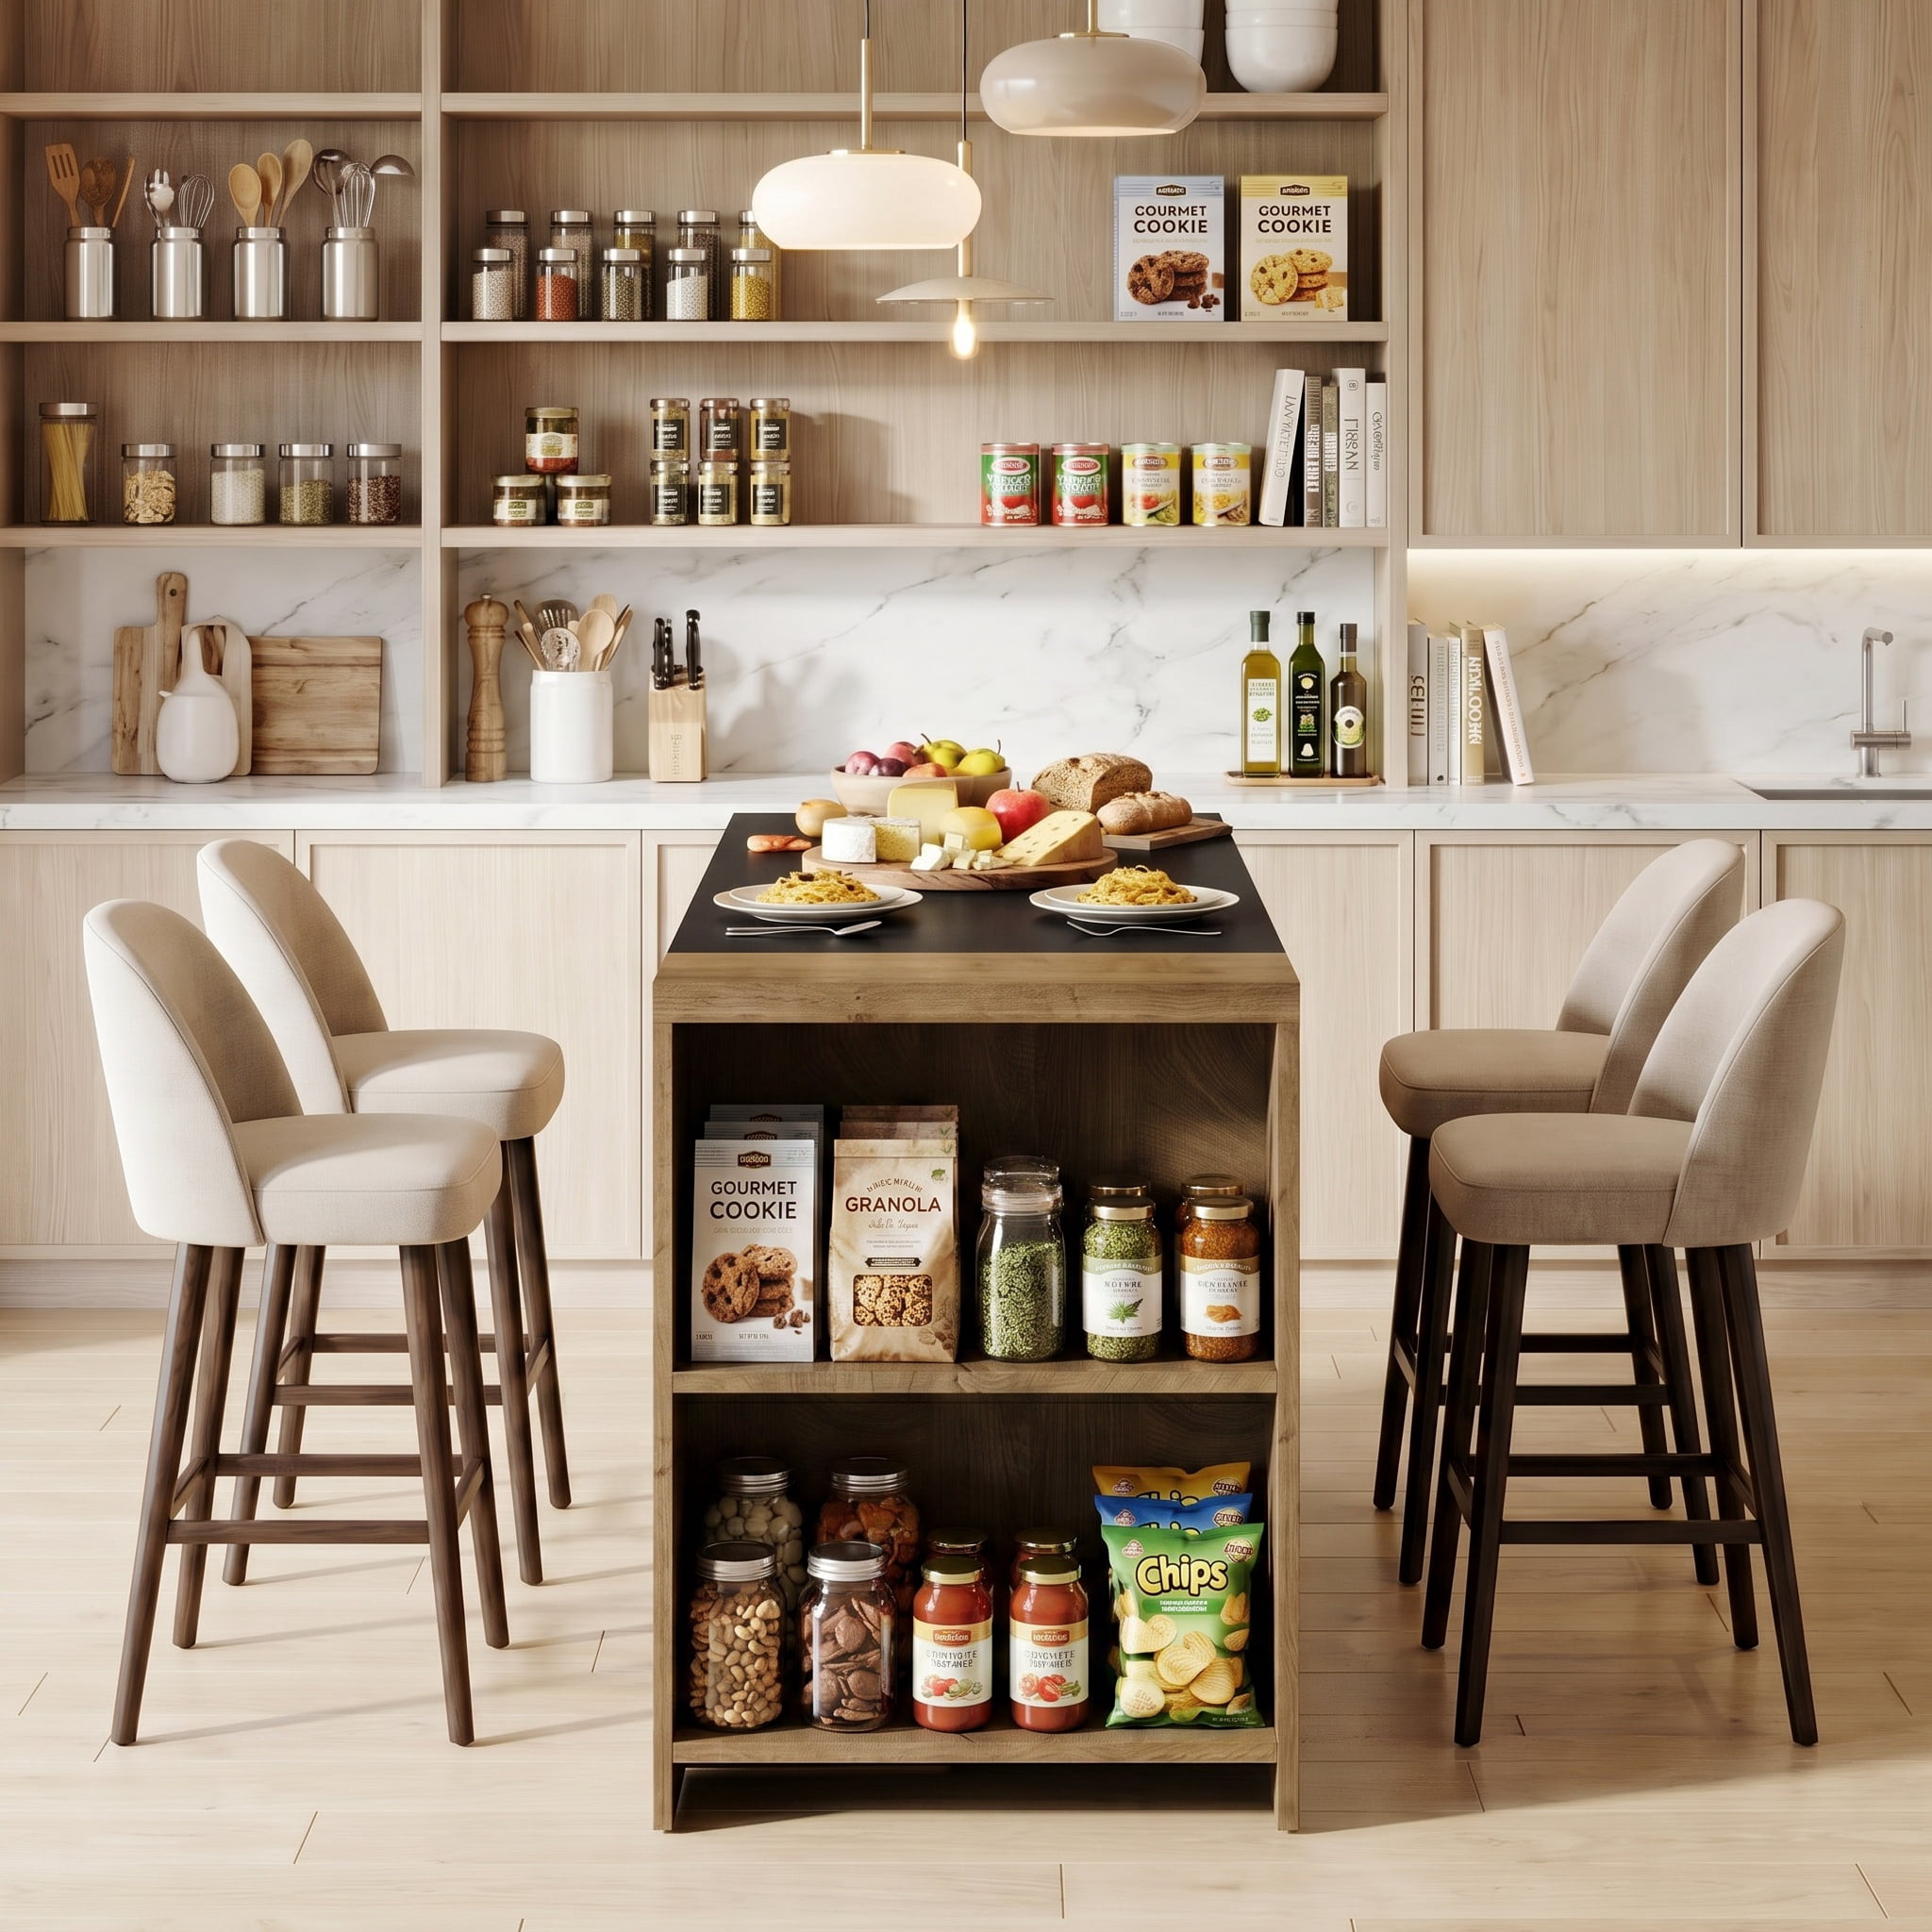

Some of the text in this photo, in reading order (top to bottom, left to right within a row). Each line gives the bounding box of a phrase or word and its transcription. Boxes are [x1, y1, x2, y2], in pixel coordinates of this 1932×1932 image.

[1135, 205, 1208, 217] GOURMET
[1258, 205, 1331, 217] GOURMET
[1134, 220, 1208, 233] COOKIE
[1257, 220, 1332, 233] COOKIE
[710, 1180, 797, 1195] GOURMET
[709, 1201, 797, 1220] COOKIE
[845, 1196, 942, 1213] GRANOLA
[1136, 1554, 1229, 1596] Chips
